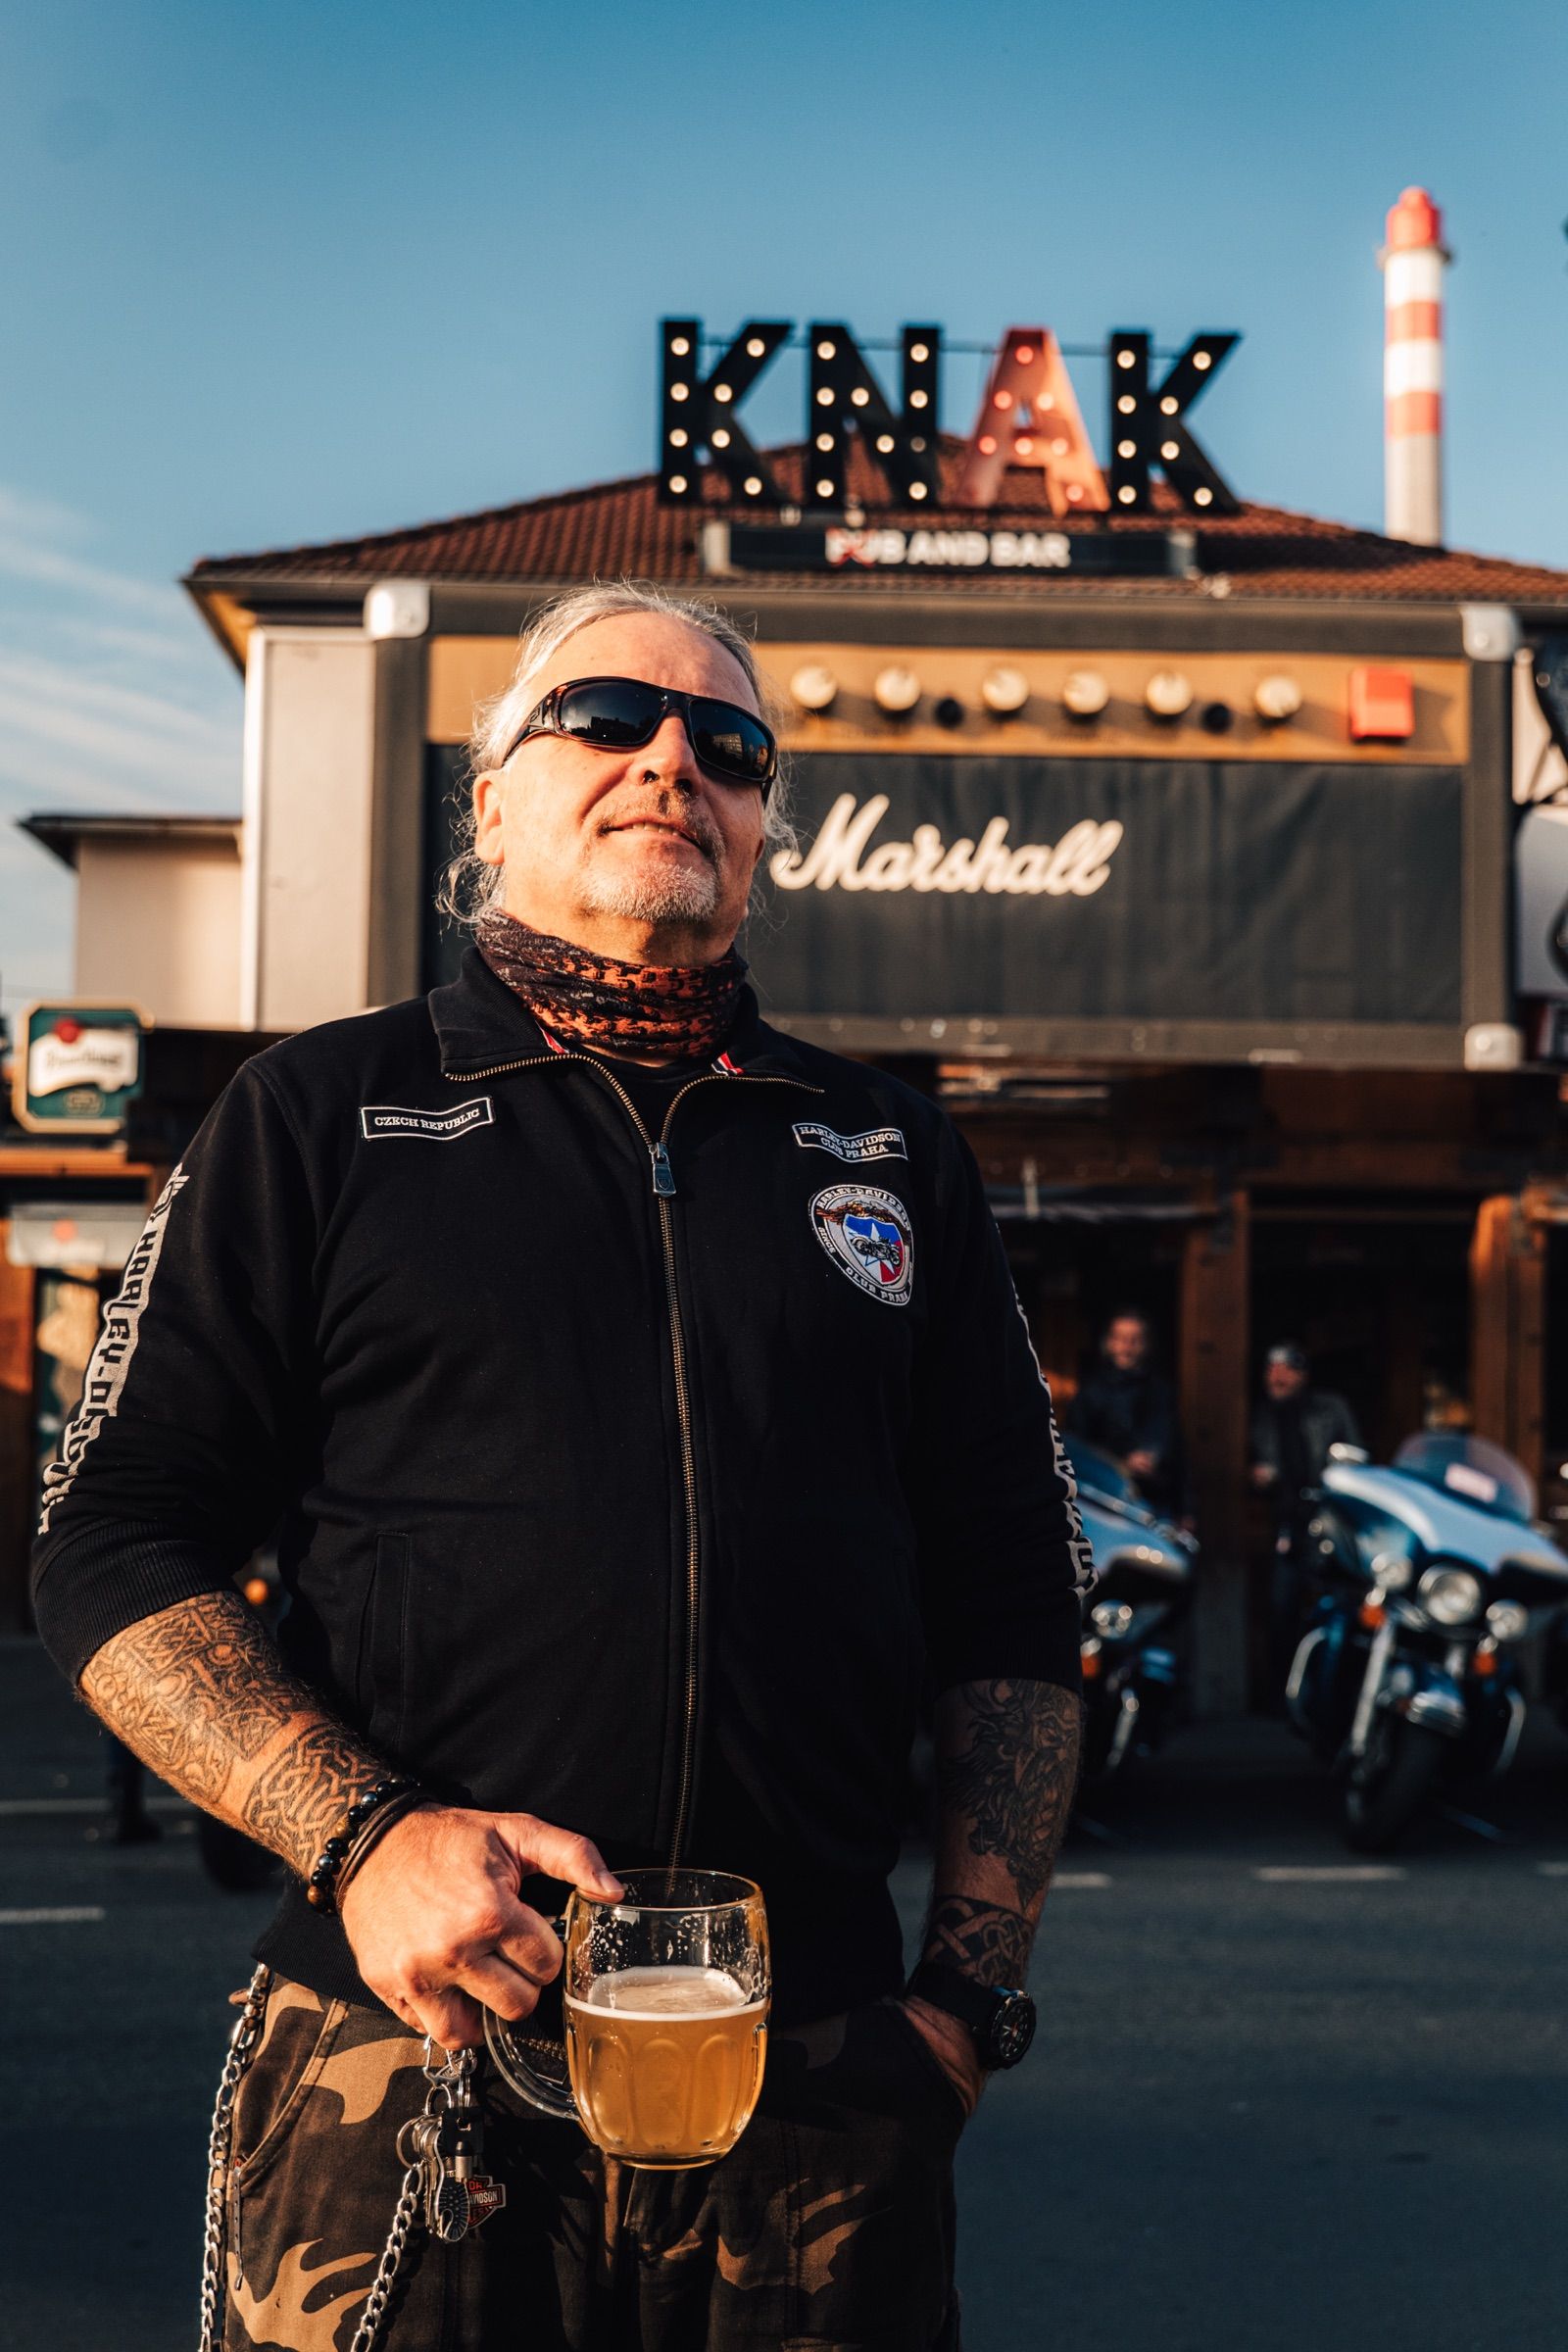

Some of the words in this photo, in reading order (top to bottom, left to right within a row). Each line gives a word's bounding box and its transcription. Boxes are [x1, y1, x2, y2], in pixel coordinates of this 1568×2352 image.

[659, 318, 1243, 516] KNAK
[826, 529, 906, 564] PUB
[906, 530, 989, 566] AND
[991, 532, 1071, 568] BAR
[769, 793, 1124, 897] Marshall
[374, 1116, 418, 1127] CZECH
[420, 1108, 480, 1130] REPUBLIC
[799, 1126, 901, 1149] HARLEY-DAVIDSON
[820, 1137, 843, 1155] CLUB
[846, 1144, 889, 1158] PRAHA
[818, 1226, 836, 1253] SINCE
[846, 1266, 876, 1293] CLUB
